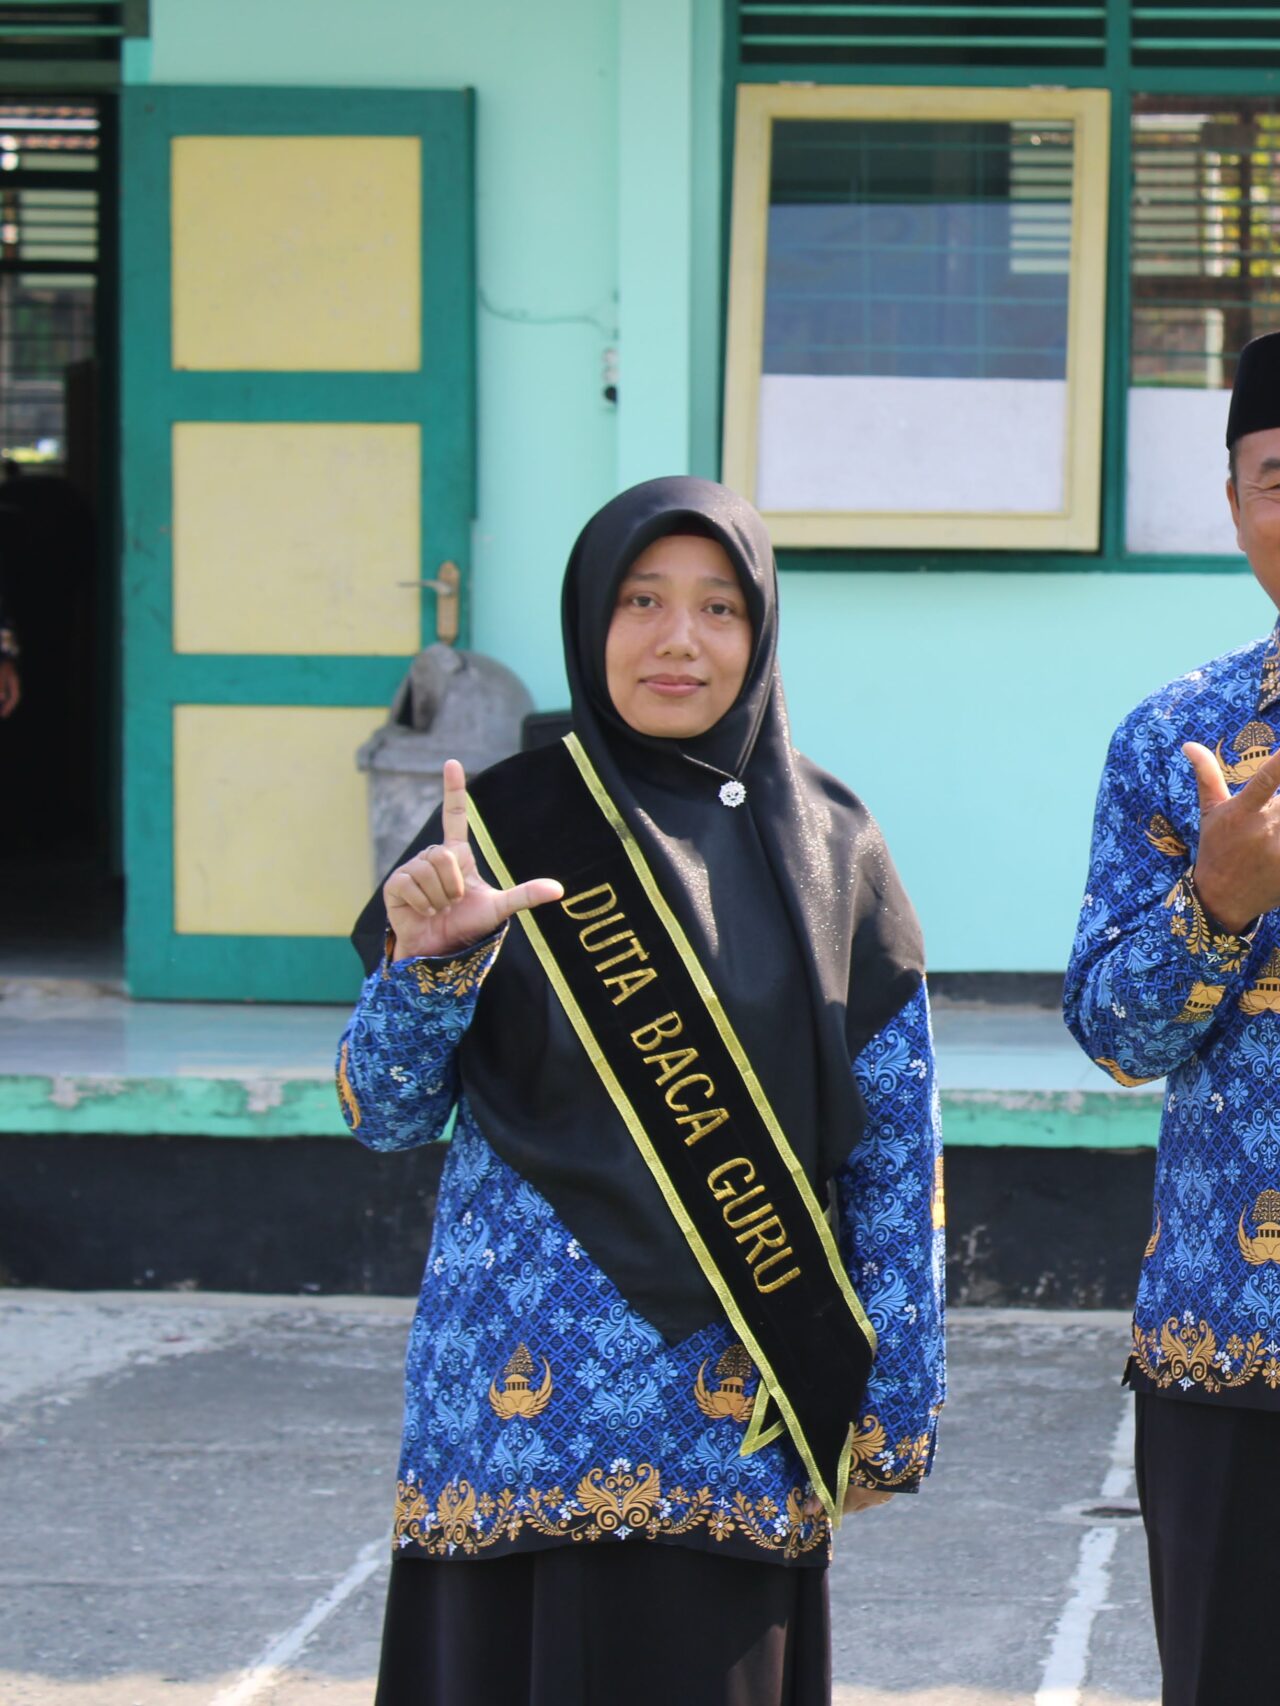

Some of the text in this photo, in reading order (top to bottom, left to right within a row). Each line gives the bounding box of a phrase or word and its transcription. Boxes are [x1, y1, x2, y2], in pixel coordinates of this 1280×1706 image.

[560, 882, 801, 1294] DUTA BACA GURU
